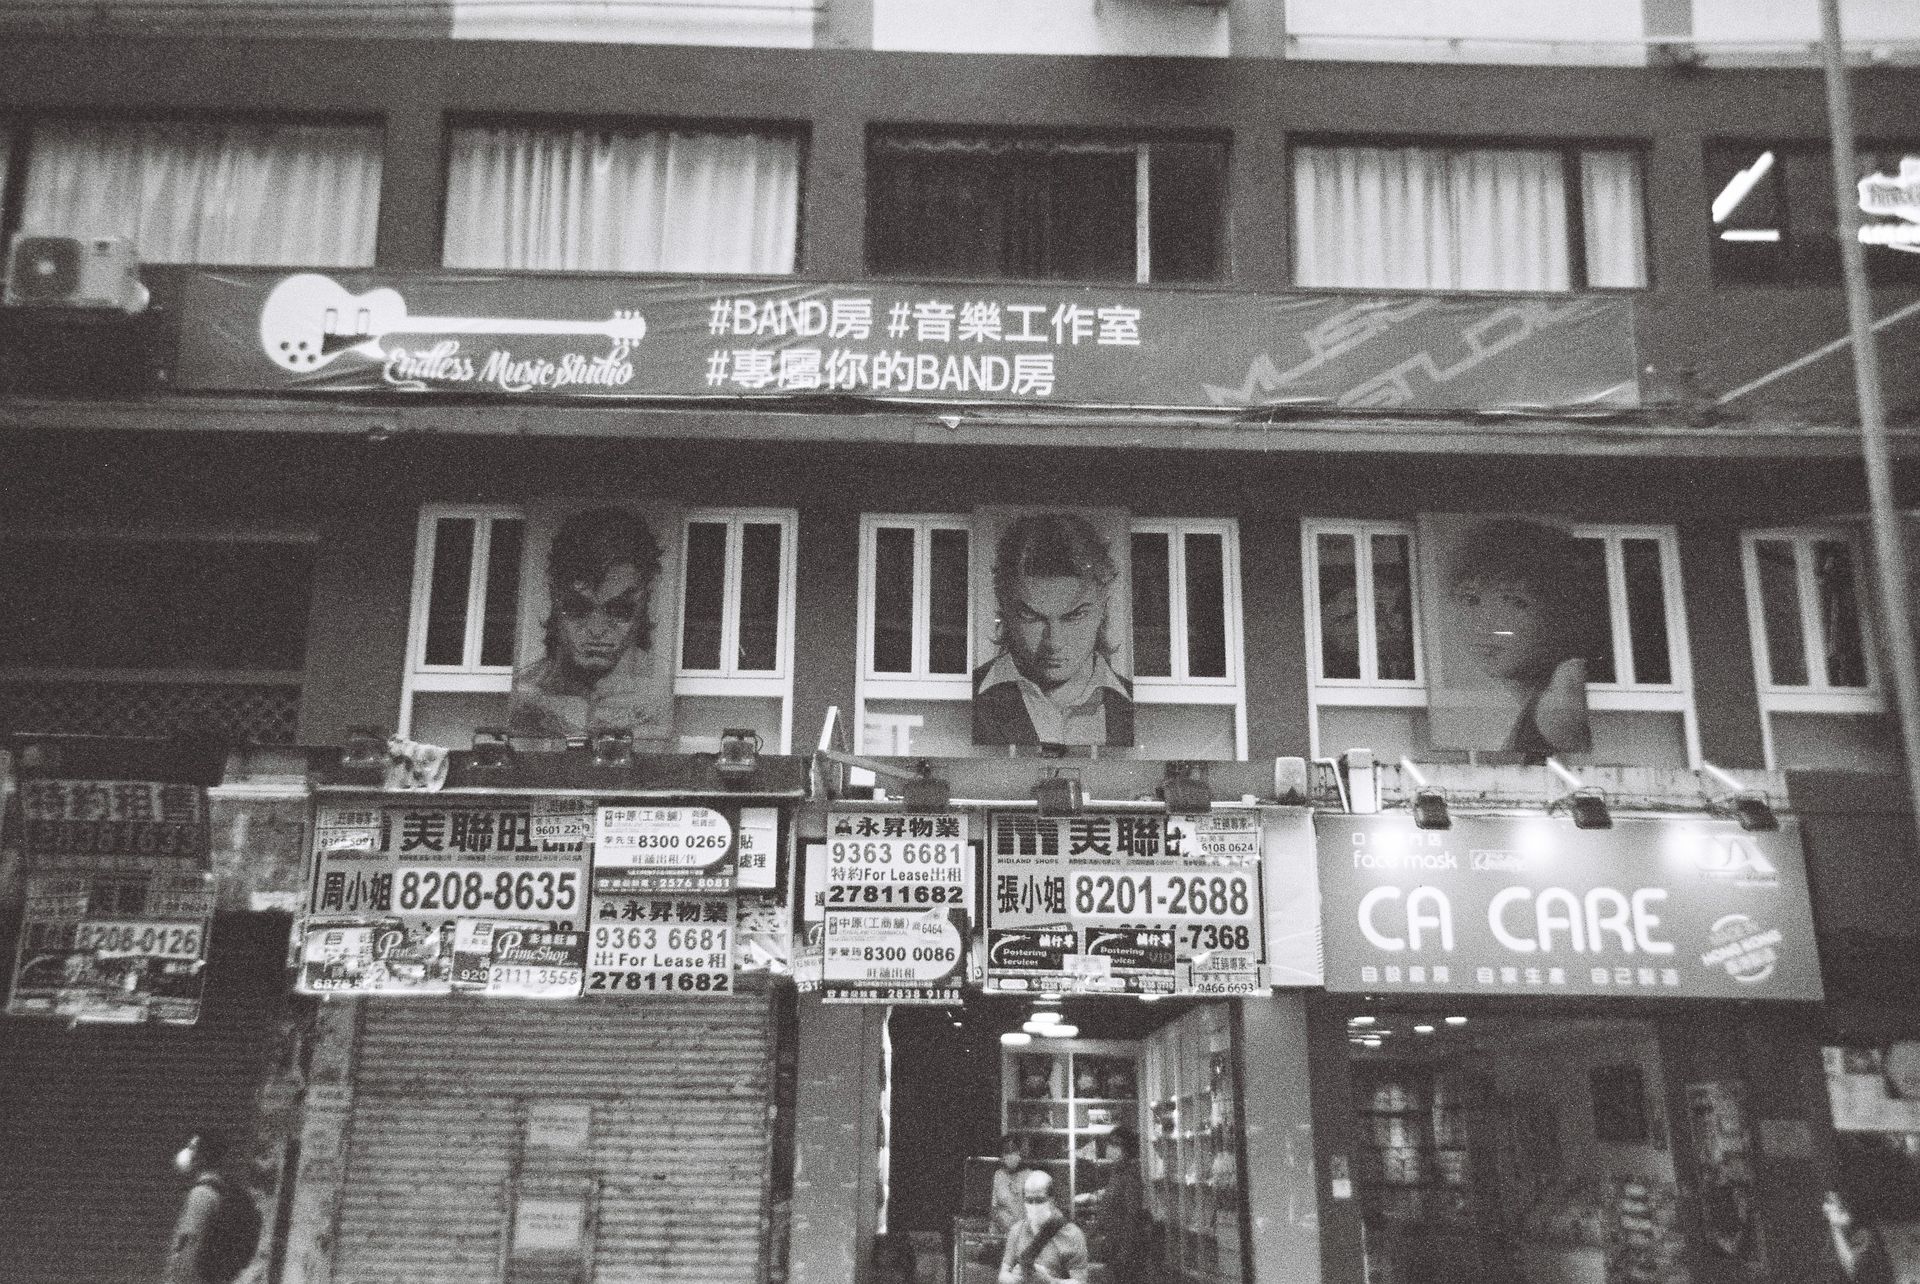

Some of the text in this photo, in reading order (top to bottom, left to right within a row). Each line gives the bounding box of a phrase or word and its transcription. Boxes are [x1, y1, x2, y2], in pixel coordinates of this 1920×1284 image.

[709, 298, 1142, 347] #BAND房 #音樂工作室
[382, 341, 634, 392] Endless Music Studio
[705, 349, 1056, 396] #專屬你的BAND房
[638, 834, 680, 849] 8300
[685, 834, 728, 849] 0265
[832, 843, 961, 865] 9363 6681
[1403, 850, 1459, 869] mask
[400, 871, 577, 911] 8208-8635
[659, 879, 693, 889] 2576
[828, 885, 964, 904] 27811682
[996, 874, 1249, 915] 張小姐 8201-2688
[1358, 885, 1675, 954] CA CARE
[594, 927, 658, 950] 9363
[668, 927, 728, 951] 6681
[617, 953, 648, 968] For
[653, 953, 705, 968] Lease
[863, 946, 907, 961] 8300
[912, 946, 956, 962] 0086
[494, 967, 579, 985] 2111 3555
[589, 972, 730, 992] 27811682
